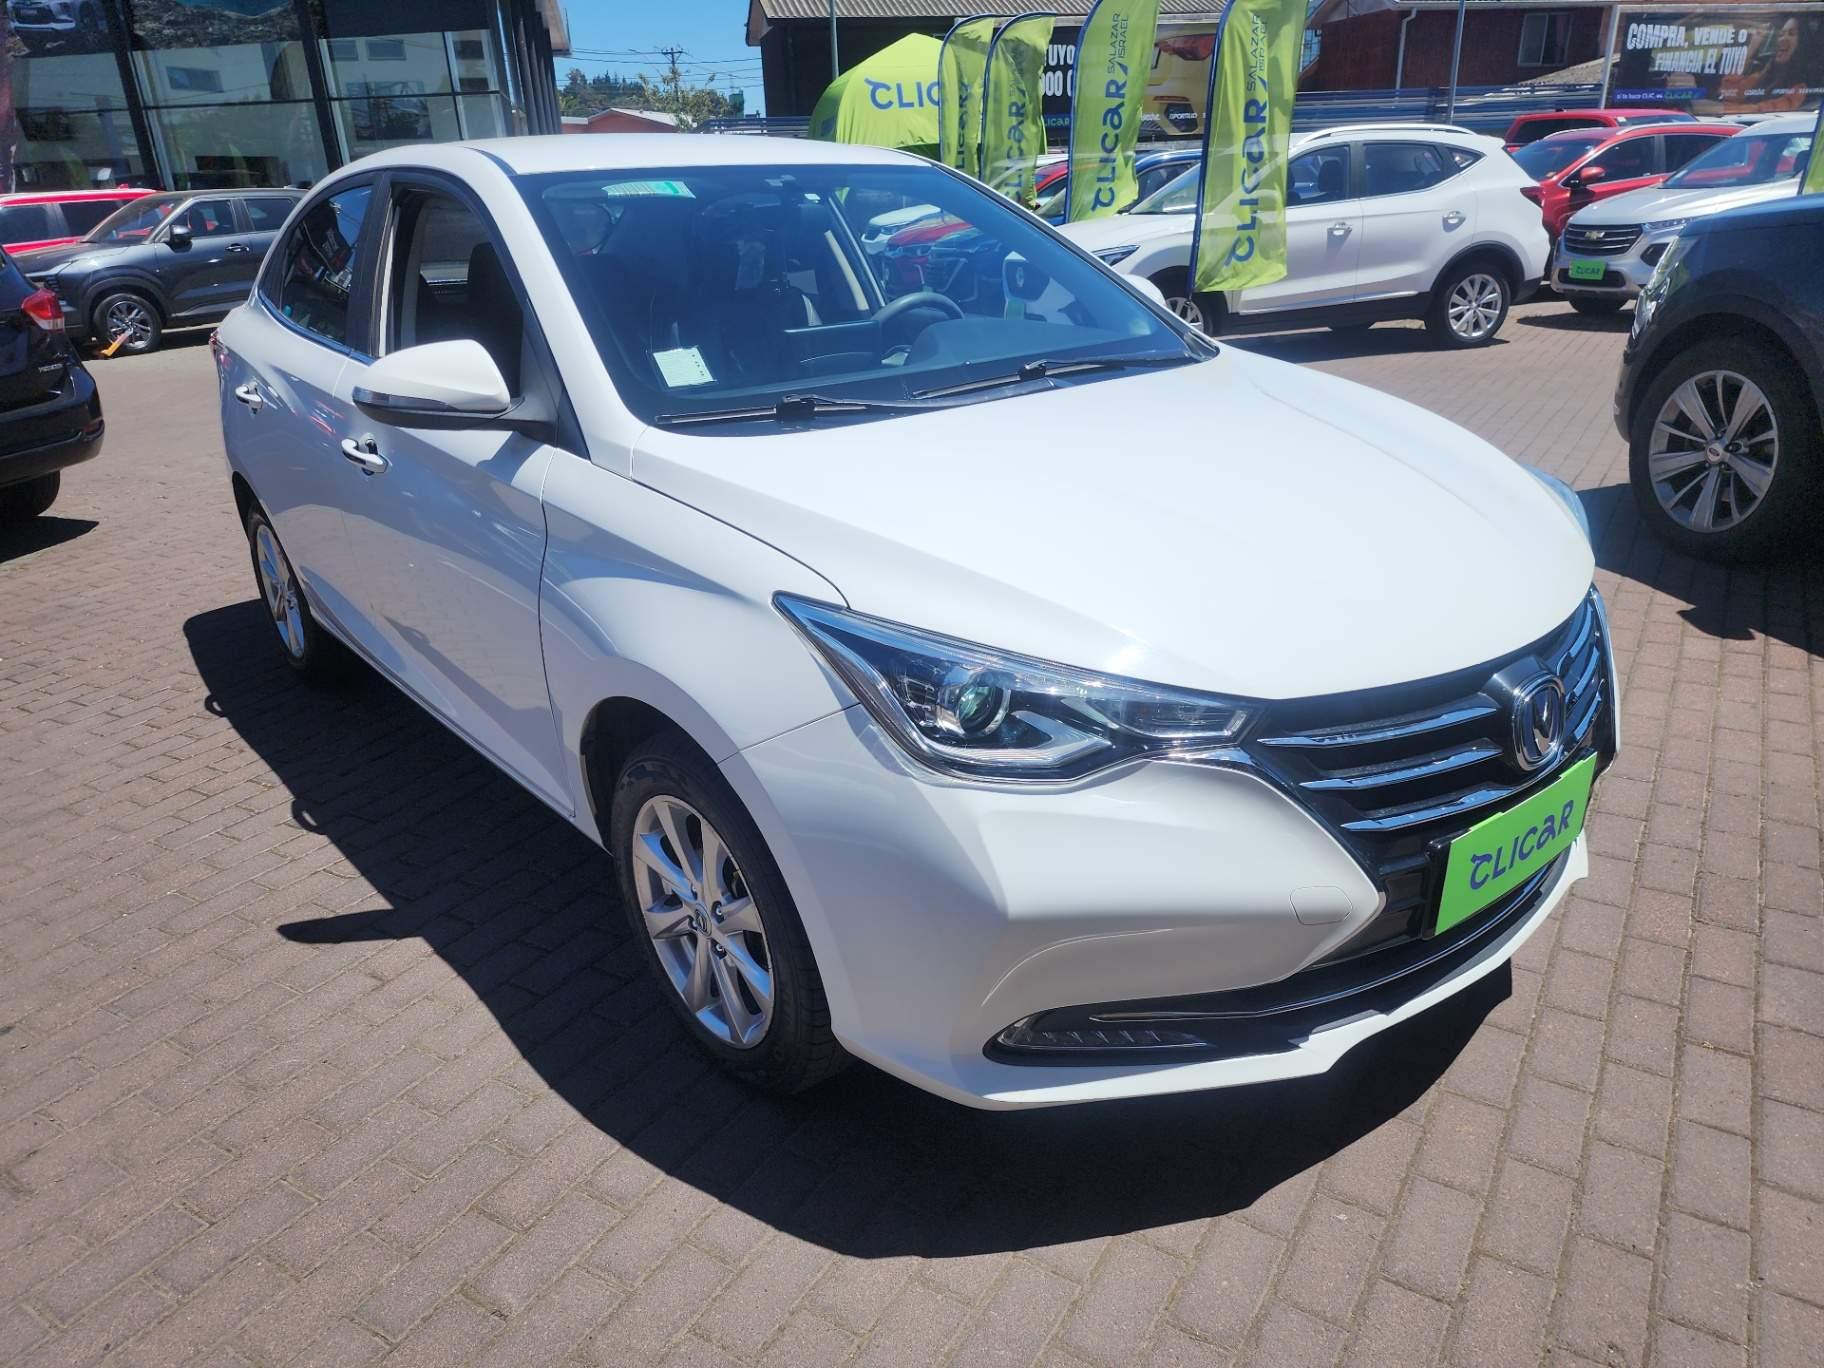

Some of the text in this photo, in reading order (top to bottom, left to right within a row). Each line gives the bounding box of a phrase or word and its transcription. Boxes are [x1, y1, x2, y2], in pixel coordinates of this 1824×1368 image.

[1107, 12, 1121, 74] SALAZAR
[1119, 16, 1129, 59] ISRAEL
[1694, 27, 1735, 46] VENDE
[1704, 47, 1718, 74] EL
[1719, 46, 1748, 75] TUYO
